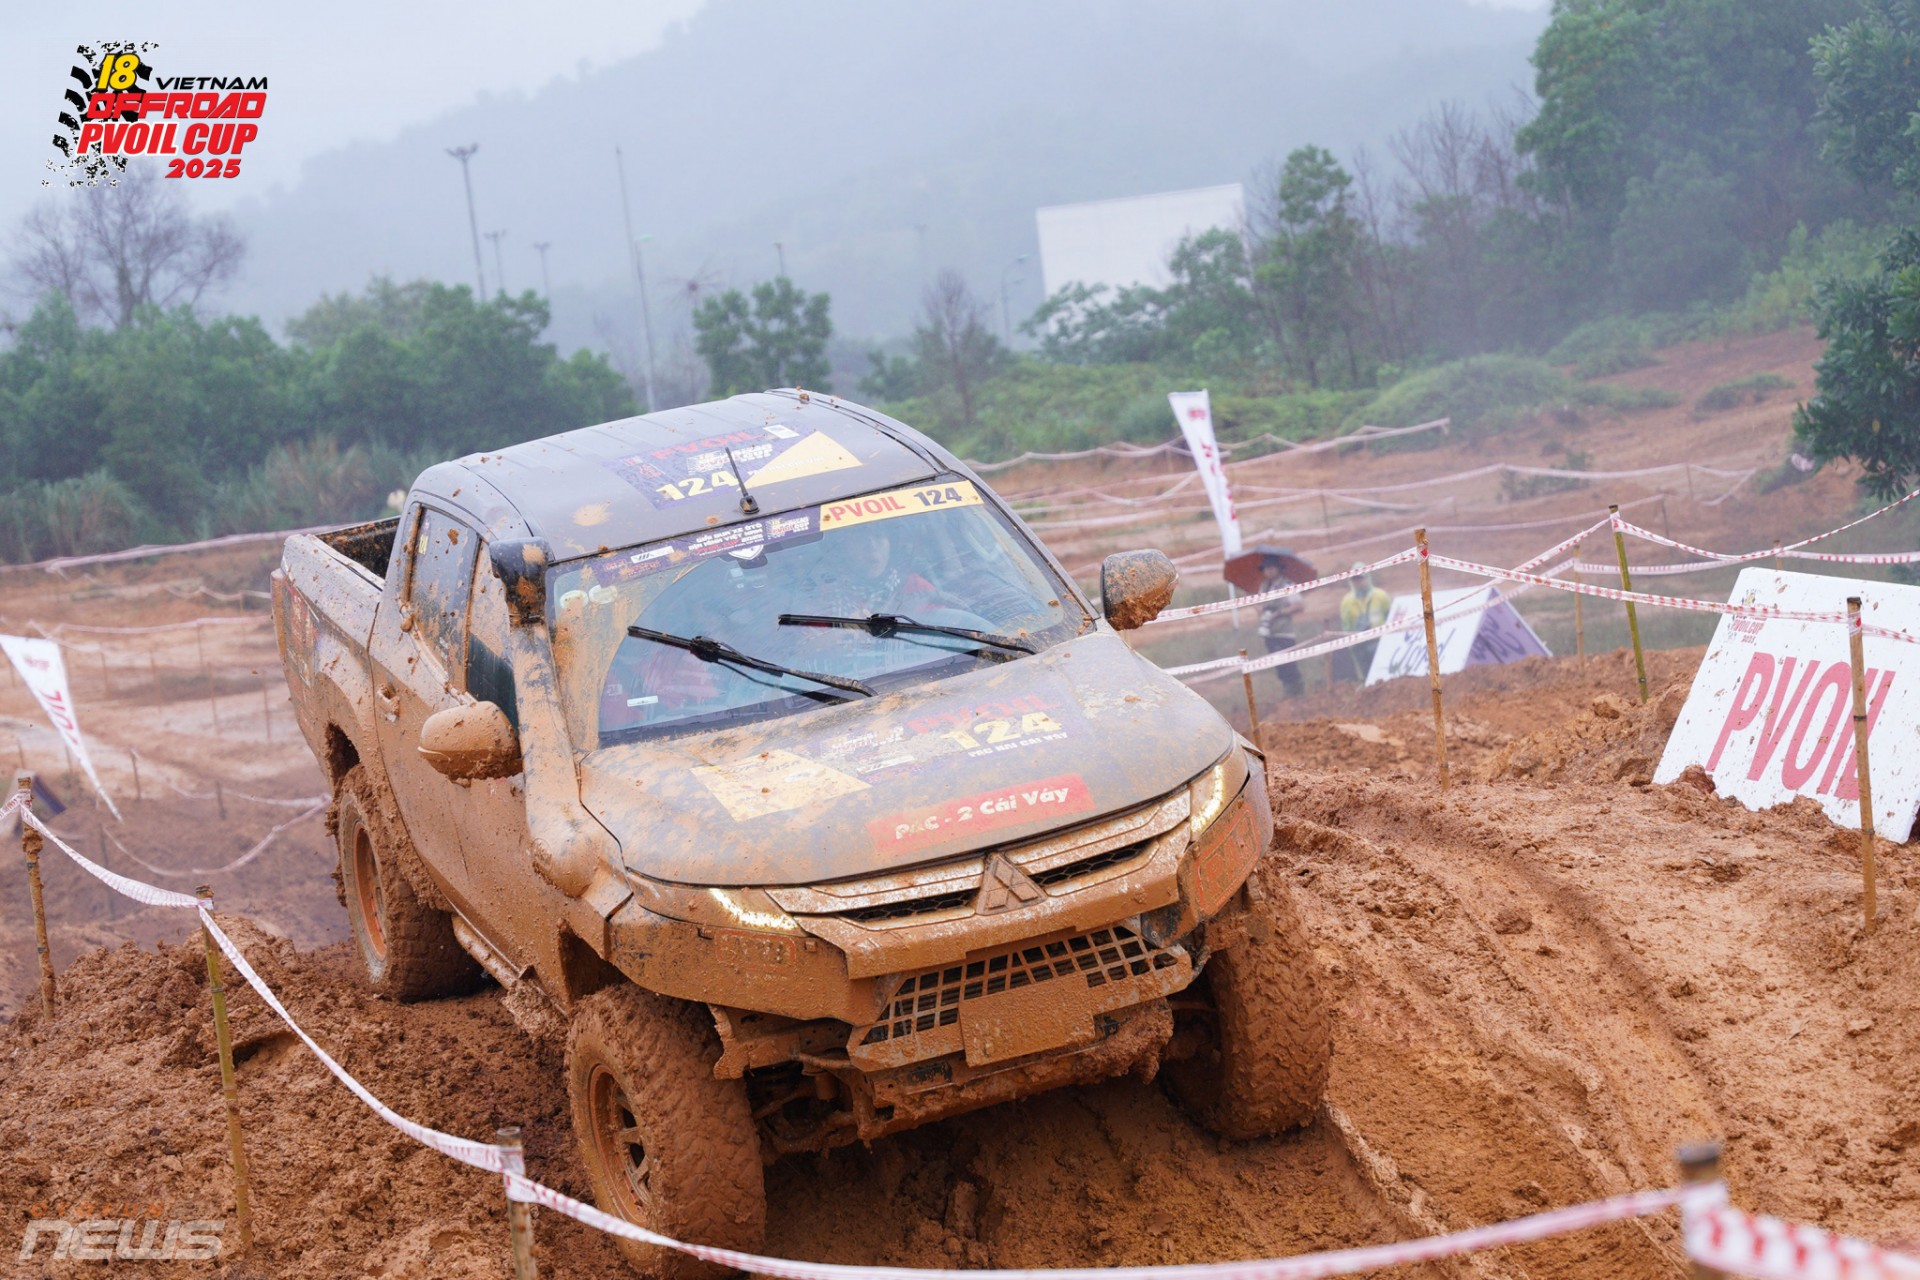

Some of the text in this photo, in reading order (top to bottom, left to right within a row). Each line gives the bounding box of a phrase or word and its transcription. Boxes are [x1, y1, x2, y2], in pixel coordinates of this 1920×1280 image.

[652, 432, 765, 460] PVOIL
[656, 470, 741, 501] 124
[828, 487, 962, 521] PVOIL 124
[907, 693, 1062, 734] PVOIL
[941, 711, 1063, 750] 124
[1704, 652, 1896, 801] PVOIL
[957, 806, 974, 822] 2
[979, 795, 1017, 815] Cái
[1021, 787, 1069, 806] Váy
